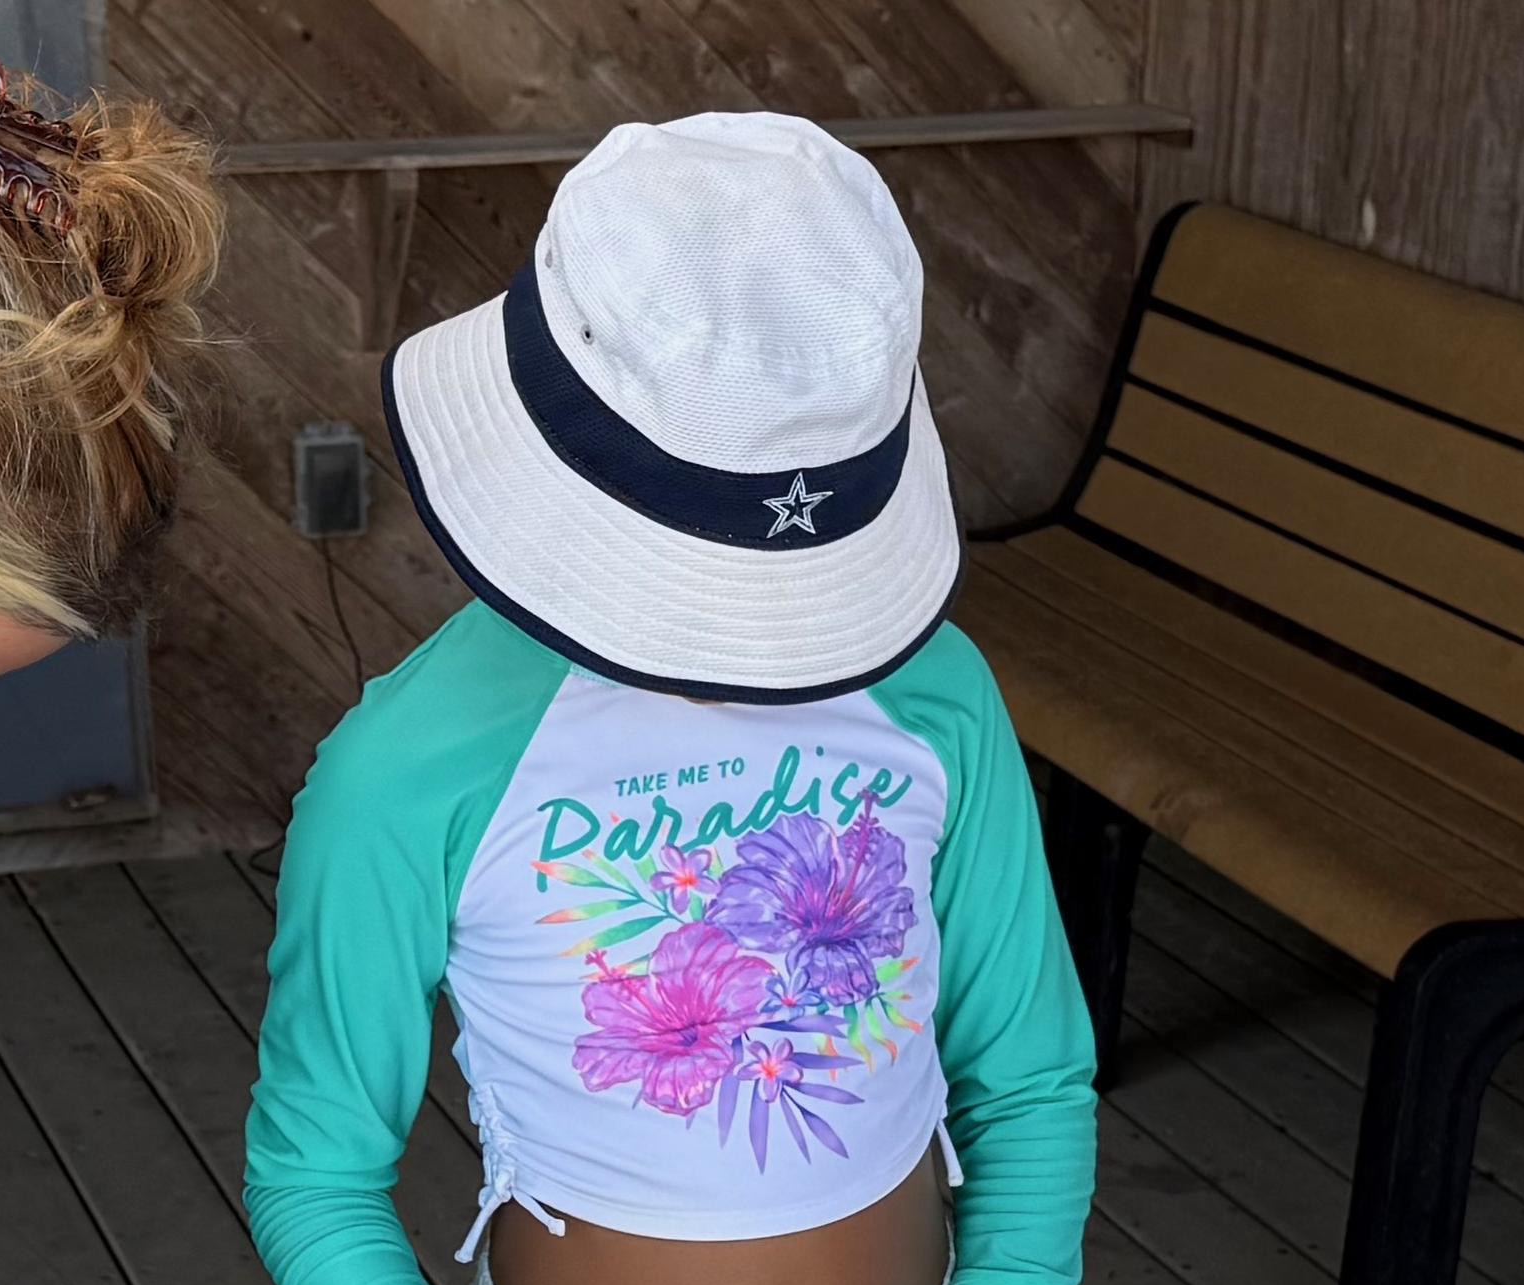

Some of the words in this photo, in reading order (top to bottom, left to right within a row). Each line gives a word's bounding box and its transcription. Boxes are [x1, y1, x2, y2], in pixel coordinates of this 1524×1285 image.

[536, 745, 913, 893] Paradise
[614, 772, 668, 798] TAKE
[677, 765, 710, 786] ME
[717, 757, 746, 777] TO
